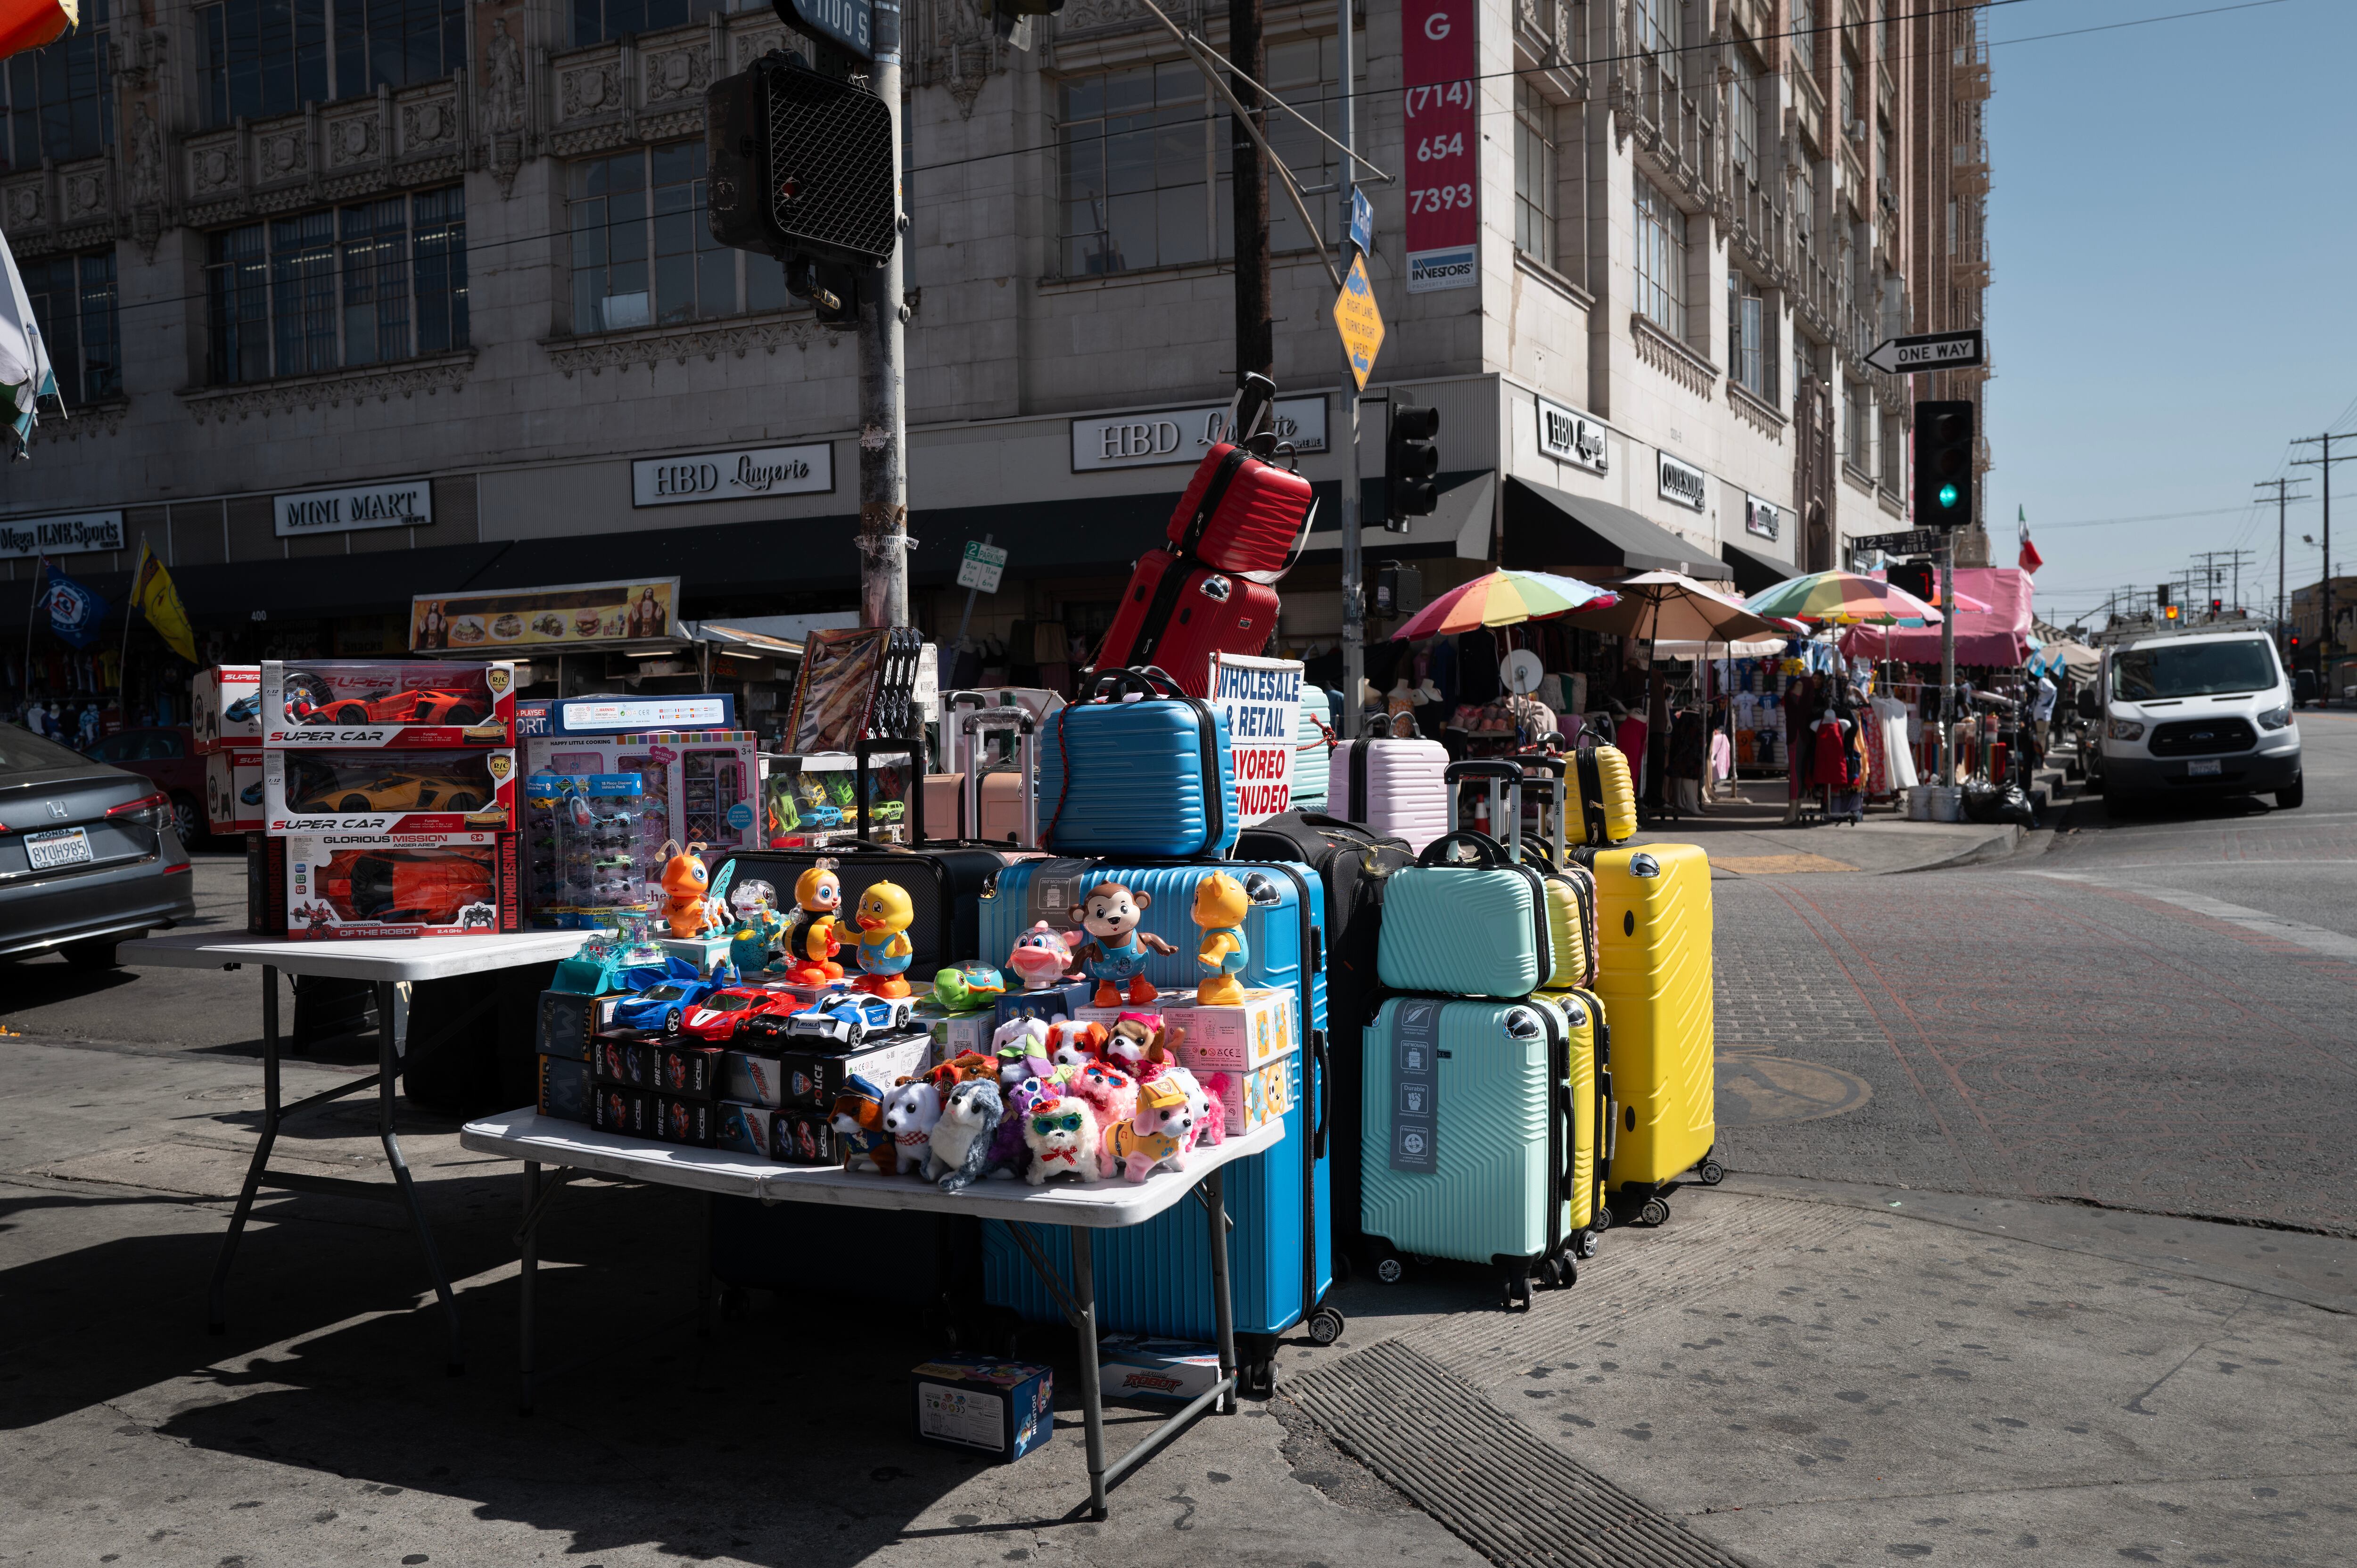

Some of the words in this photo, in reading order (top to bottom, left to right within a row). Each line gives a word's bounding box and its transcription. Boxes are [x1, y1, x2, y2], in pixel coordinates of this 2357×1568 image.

[858, 11, 870, 49] S.
[1425, 13, 1450, 40] G
[1406, 81, 1473, 117] (714)
[1417, 132, 1463, 162] 654
[1410, 184, 1473, 214] 7393
[1446, 277, 1474, 286] SERVICES
[1347, 298, 1360, 315] RIGHT
[1362, 305, 1373, 320] LANE
[1345, 318, 1360, 335] TURNS
[1362, 325, 1375, 340] RIGHT
[1353, 341, 1368, 357] AHEAD
[1899, 347, 1930, 362] ONE
[1937, 342, 1969, 358] WAY
[1098, 421, 1179, 459] HBD
[1547, 411, 1574, 450] HBD
[654, 462, 718, 496] HBD
[730, 454, 809, 491] Lingerie
[287, 499, 340, 527] MINI
[351, 491, 417, 521] MART
[74, 520, 118, 549] Sports
[968, 544, 978, 555] 2
[980, 550, 1004, 564] PARKING
[1901, 544, 1918, 553] 400
[251, 610, 267, 621] 400
[285, 631, 320, 648] mejor
[344, 640, 383, 652] Snacks
[322, 677, 397, 687] SUPER
[404, 677, 453, 687] CAR
[869, 670, 879, 693] Ultimate
[1218, 668, 1300, 702] WHOLESALE
[865, 693, 874, 713] Warrior
[861, 713, 869, 731] Power
[1238, 706, 1286, 738] RETAIL
[269, 732, 335, 741] SUPER
[340, 732, 386, 741] CAR
[38, 829, 71, 838] HONDA
[272, 820, 338, 830] SUPER
[341, 819, 386, 829] CAR
[393, 834, 447, 842] MISSION
[54, 854, 91, 865] ANGELES
[503, 835, 517, 929] TRANSFORMATION
[339, 928, 354, 937] OF
[355, 928, 373, 936] THE
[376, 928, 419, 936] ROBOT
[815, 1063, 823, 1107] POLICE
[1123, 1373, 1183, 1393] ROBOT
[1140, 1370, 1169, 1379] DEFORM
